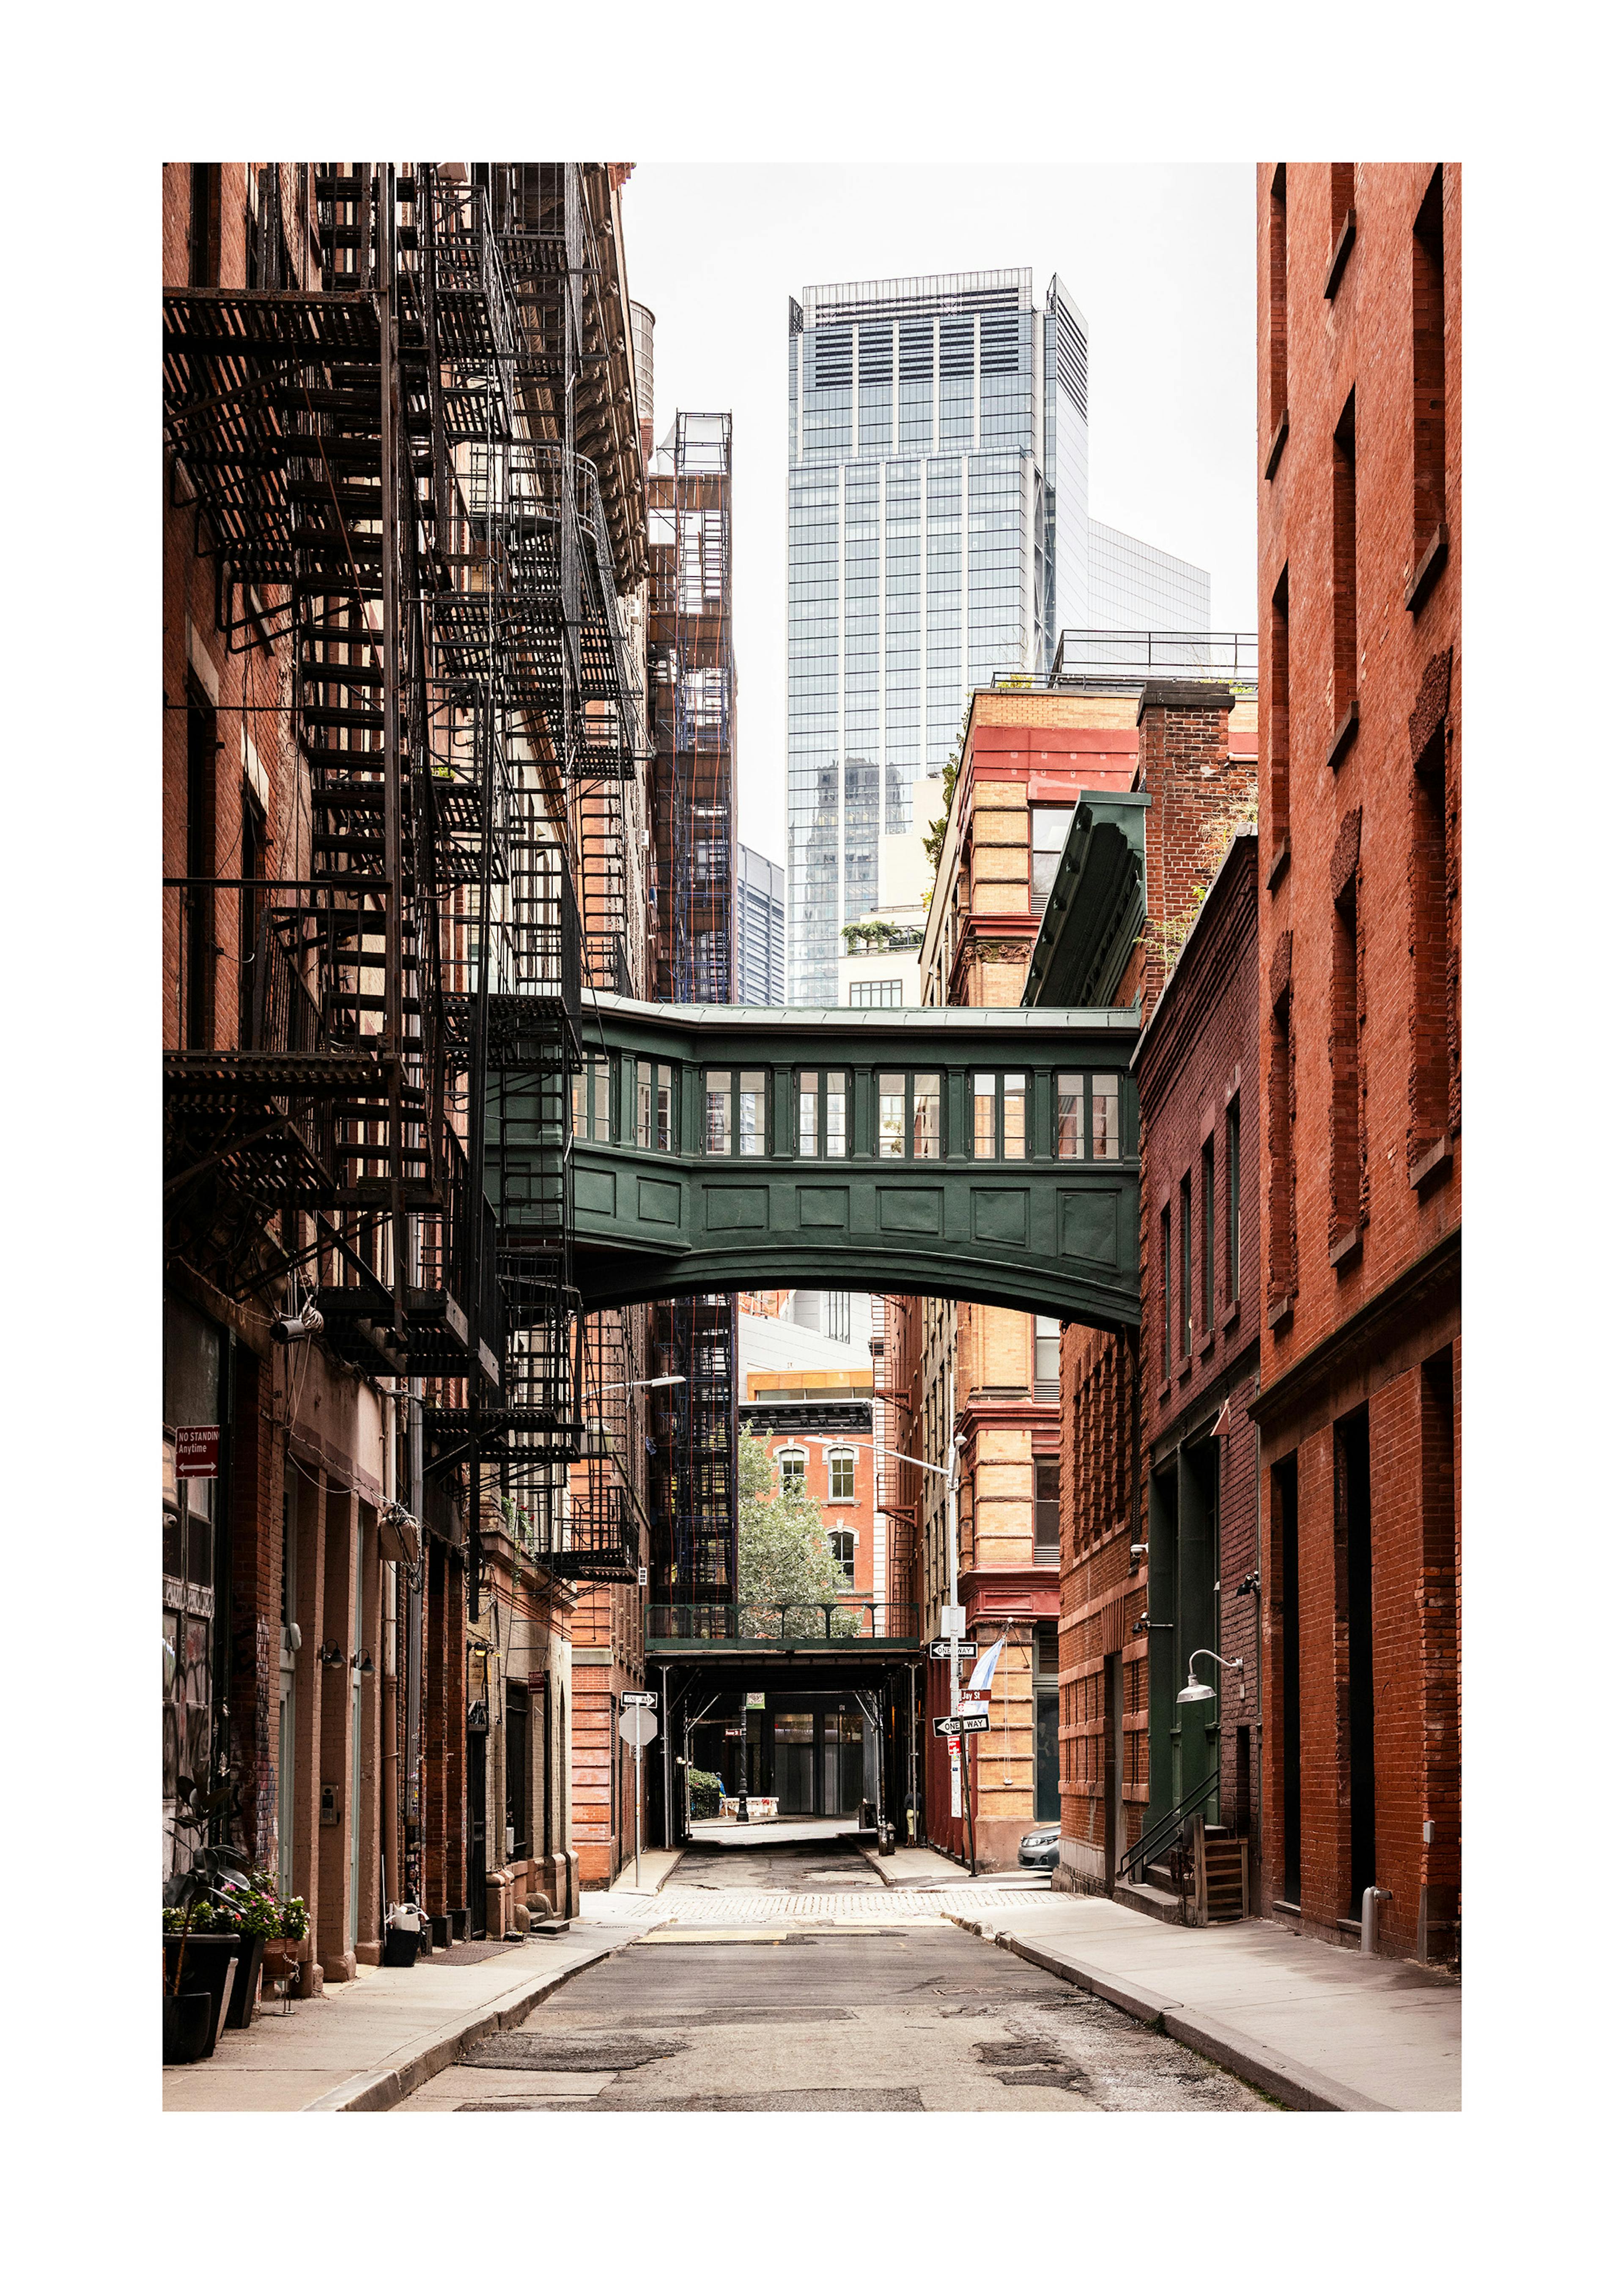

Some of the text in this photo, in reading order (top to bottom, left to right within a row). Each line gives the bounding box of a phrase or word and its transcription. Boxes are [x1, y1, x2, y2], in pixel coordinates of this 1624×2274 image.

[179, 1431, 220, 1442] NO STANDIN
[178, 1444, 207, 1455] Anytime
[962, 1692, 972, 1700] Jay
[945, 1720, 982, 1730] ONE WAY
